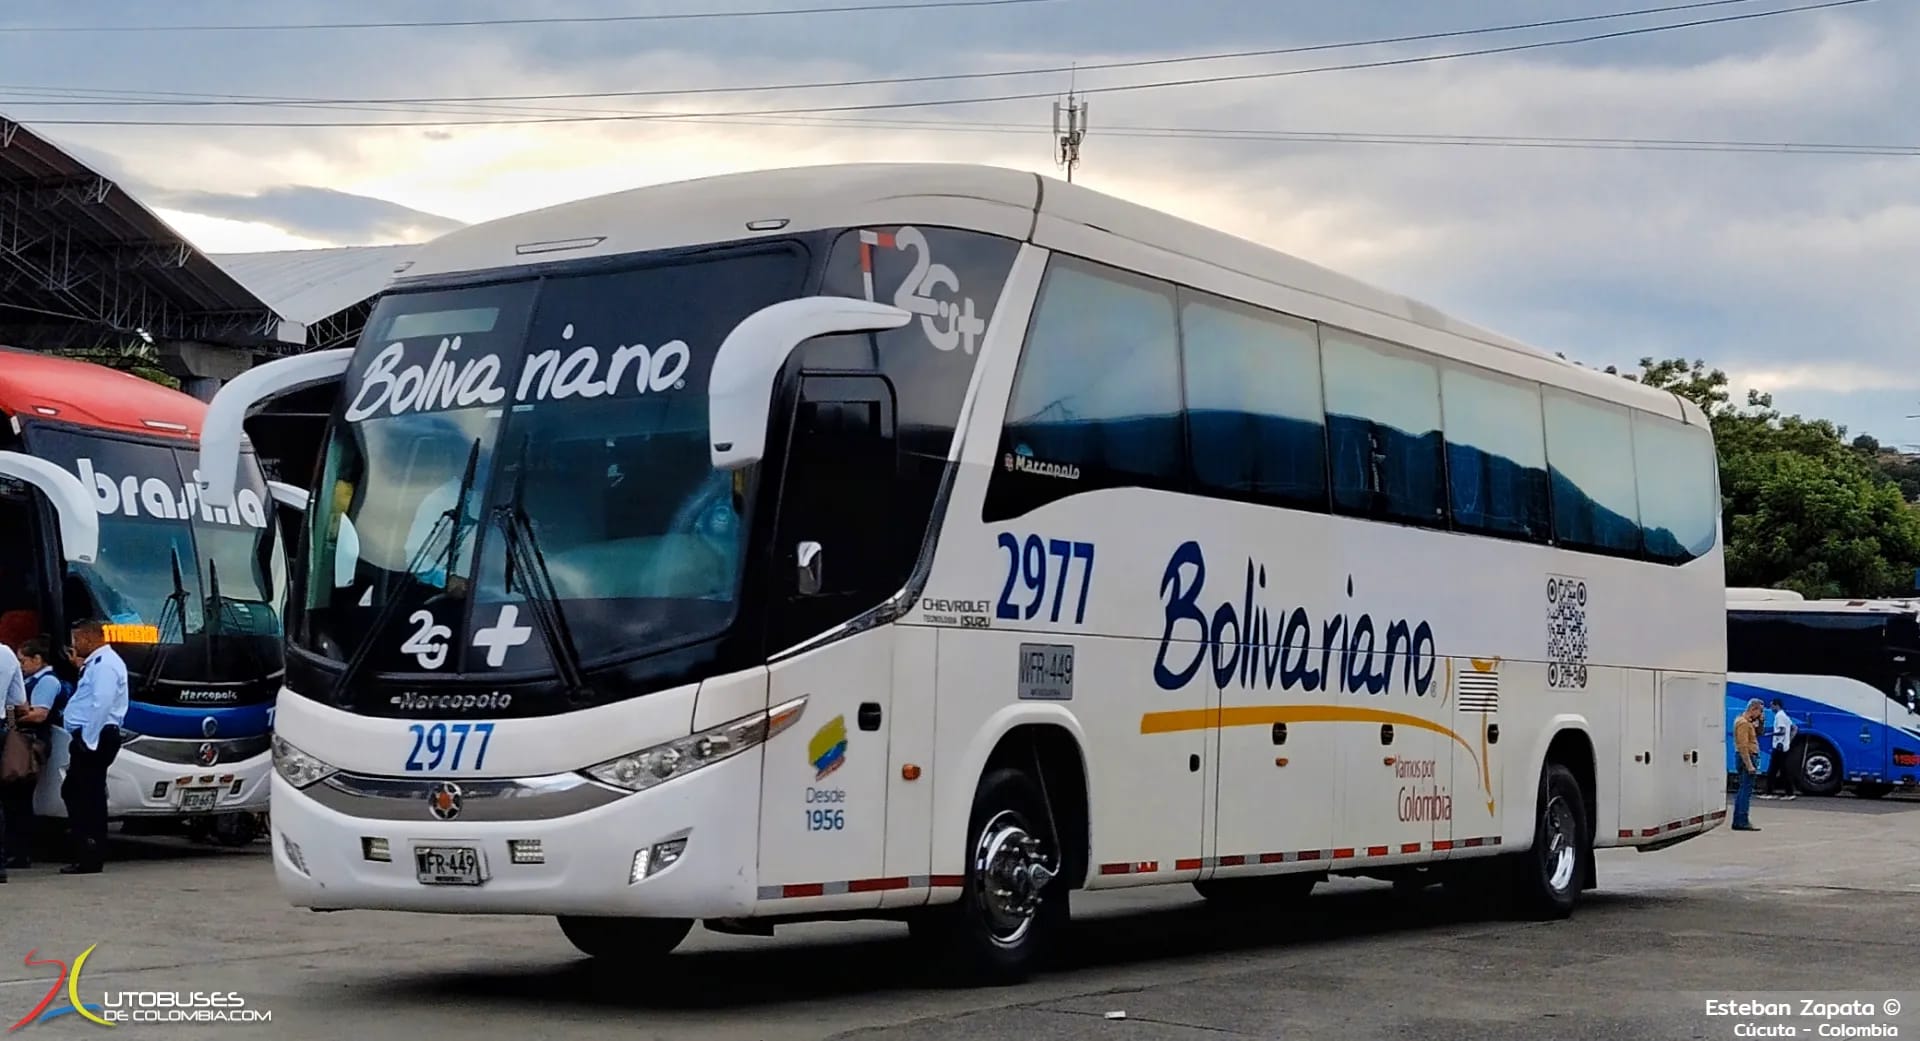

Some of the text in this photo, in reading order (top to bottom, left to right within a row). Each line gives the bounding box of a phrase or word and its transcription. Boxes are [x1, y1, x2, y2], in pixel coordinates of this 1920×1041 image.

[1015, 455, 1080, 479] Marcopolo
[995, 531, 1095, 625] 2977
[922, 598, 991, 613] CHEVROLET
[960, 615, 991, 627] ISUZU
[1021, 652, 1072, 685] WFR-449
[180, 689, 238, 702] Marcopolo
[399, 691, 512, 712] Marcopolo
[405, 722, 496, 771] 2977
[1421, 760, 1436, 784] por
[806, 787, 846, 803] Desde
[1398, 785, 1452, 822] Colombia
[806, 809, 845, 831] 1956
